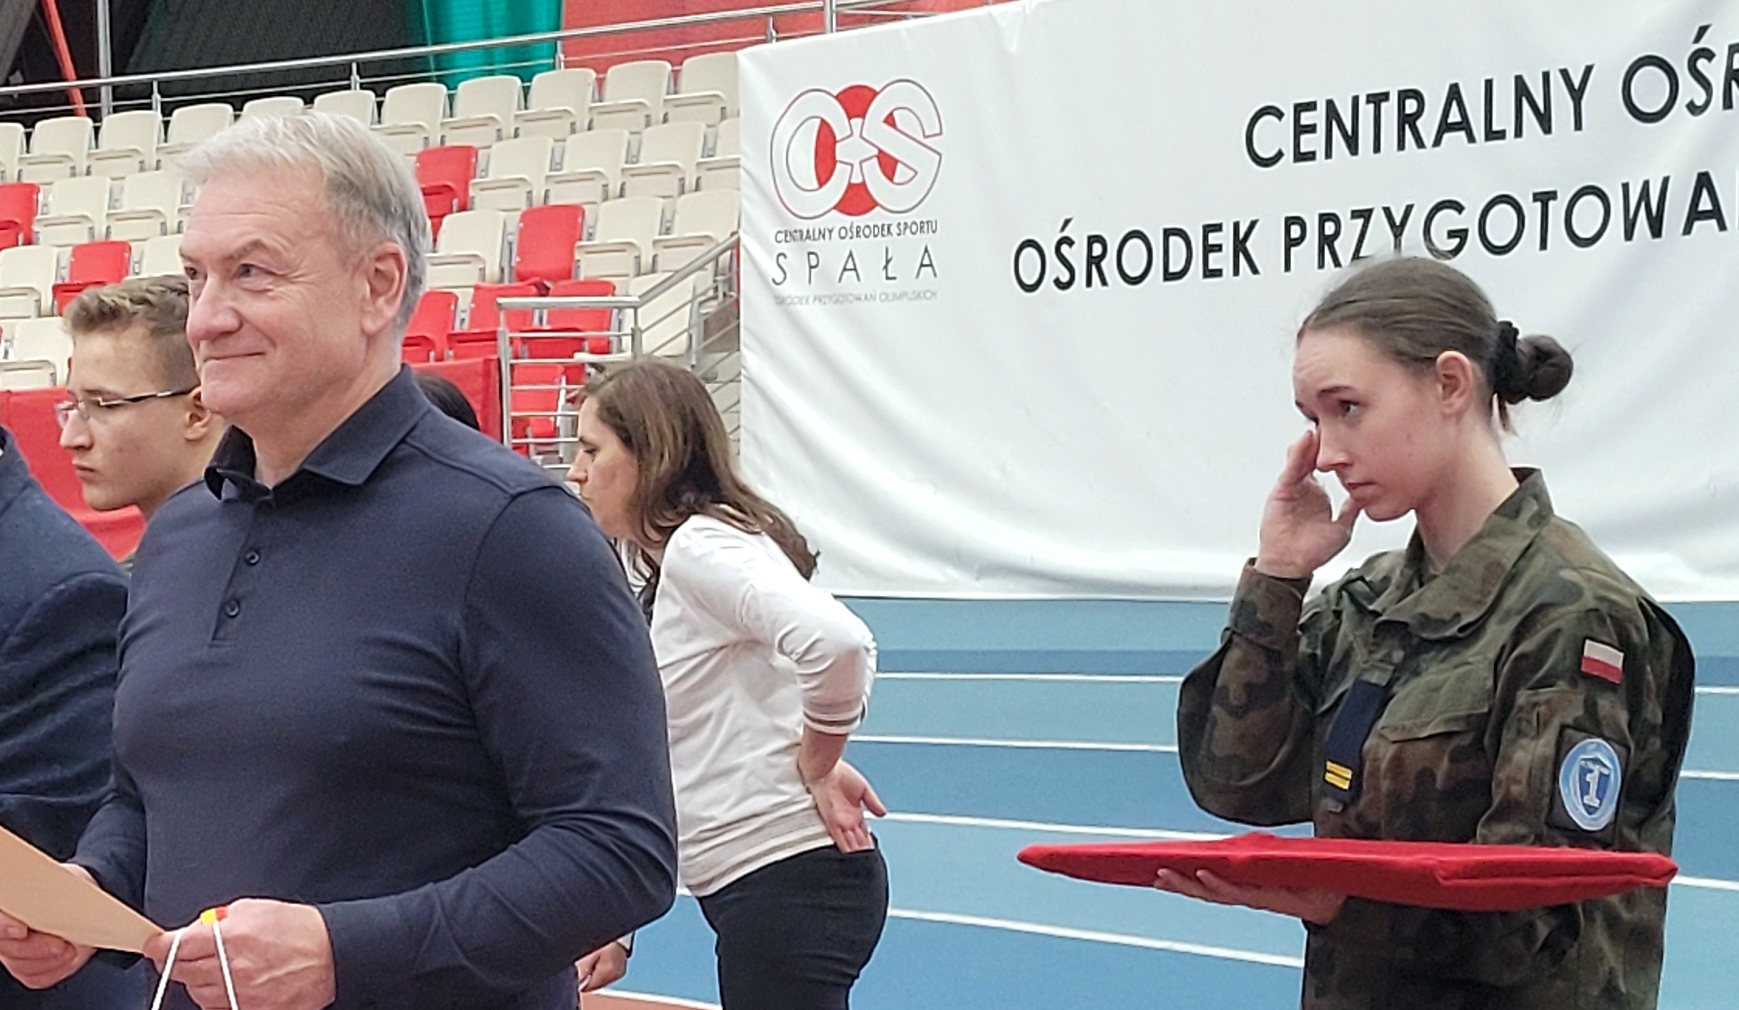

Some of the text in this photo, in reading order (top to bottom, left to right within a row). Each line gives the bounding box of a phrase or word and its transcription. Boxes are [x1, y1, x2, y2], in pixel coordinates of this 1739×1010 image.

[1245, 63, 1595, 168] CENTRALNY
[774, 219, 938, 243] CENTRALNY OŚRODEK SPORTU
[1013, 217, 1261, 293] OŚRODEK
[771, 244, 938, 286] SPAŁA
